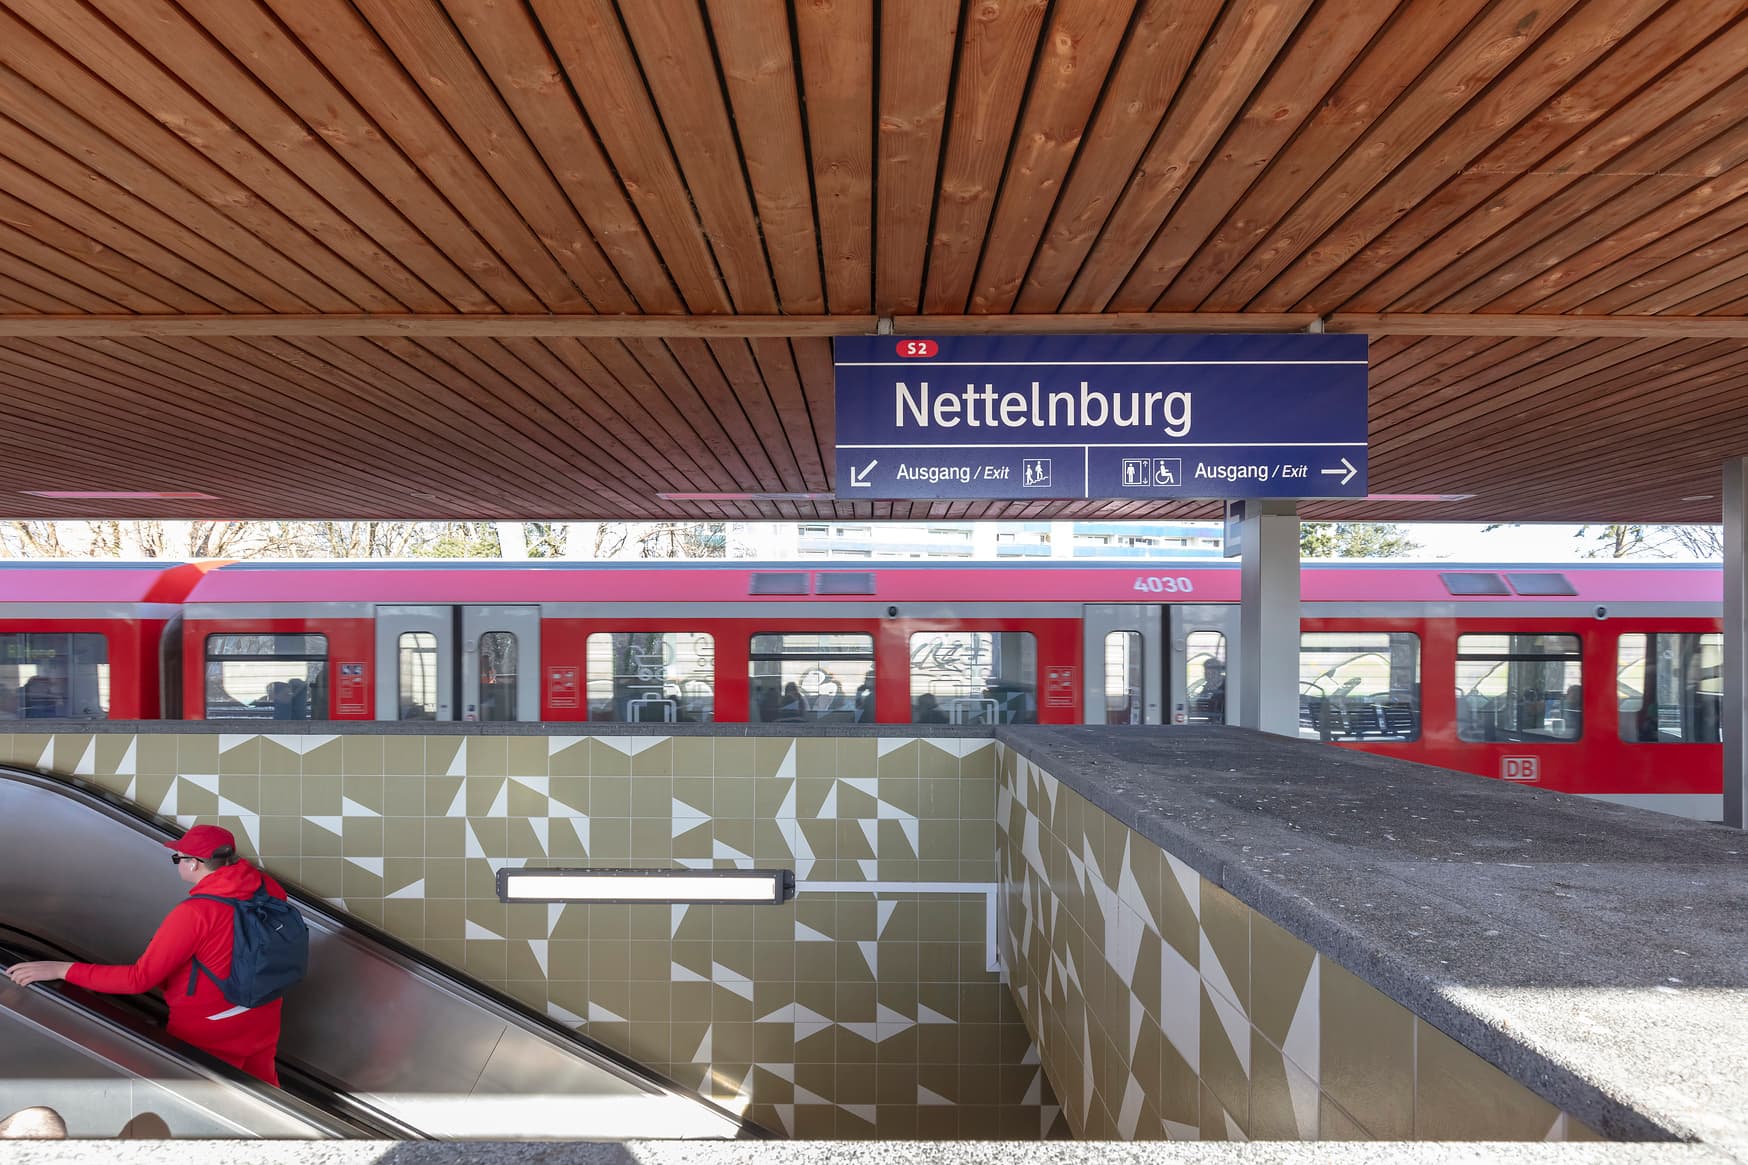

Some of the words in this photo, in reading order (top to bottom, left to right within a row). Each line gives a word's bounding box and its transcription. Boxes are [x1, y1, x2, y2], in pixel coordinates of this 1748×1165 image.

[907, 342, 927, 355] S2
[895, 381, 1192, 438] Nettelnburg
[896, 464, 970, 483] Ausgang
[1195, 463, 1268, 481] Ausgang
[1133, 576, 1193, 593] 4030
[1507, 760, 1534, 777] DB
